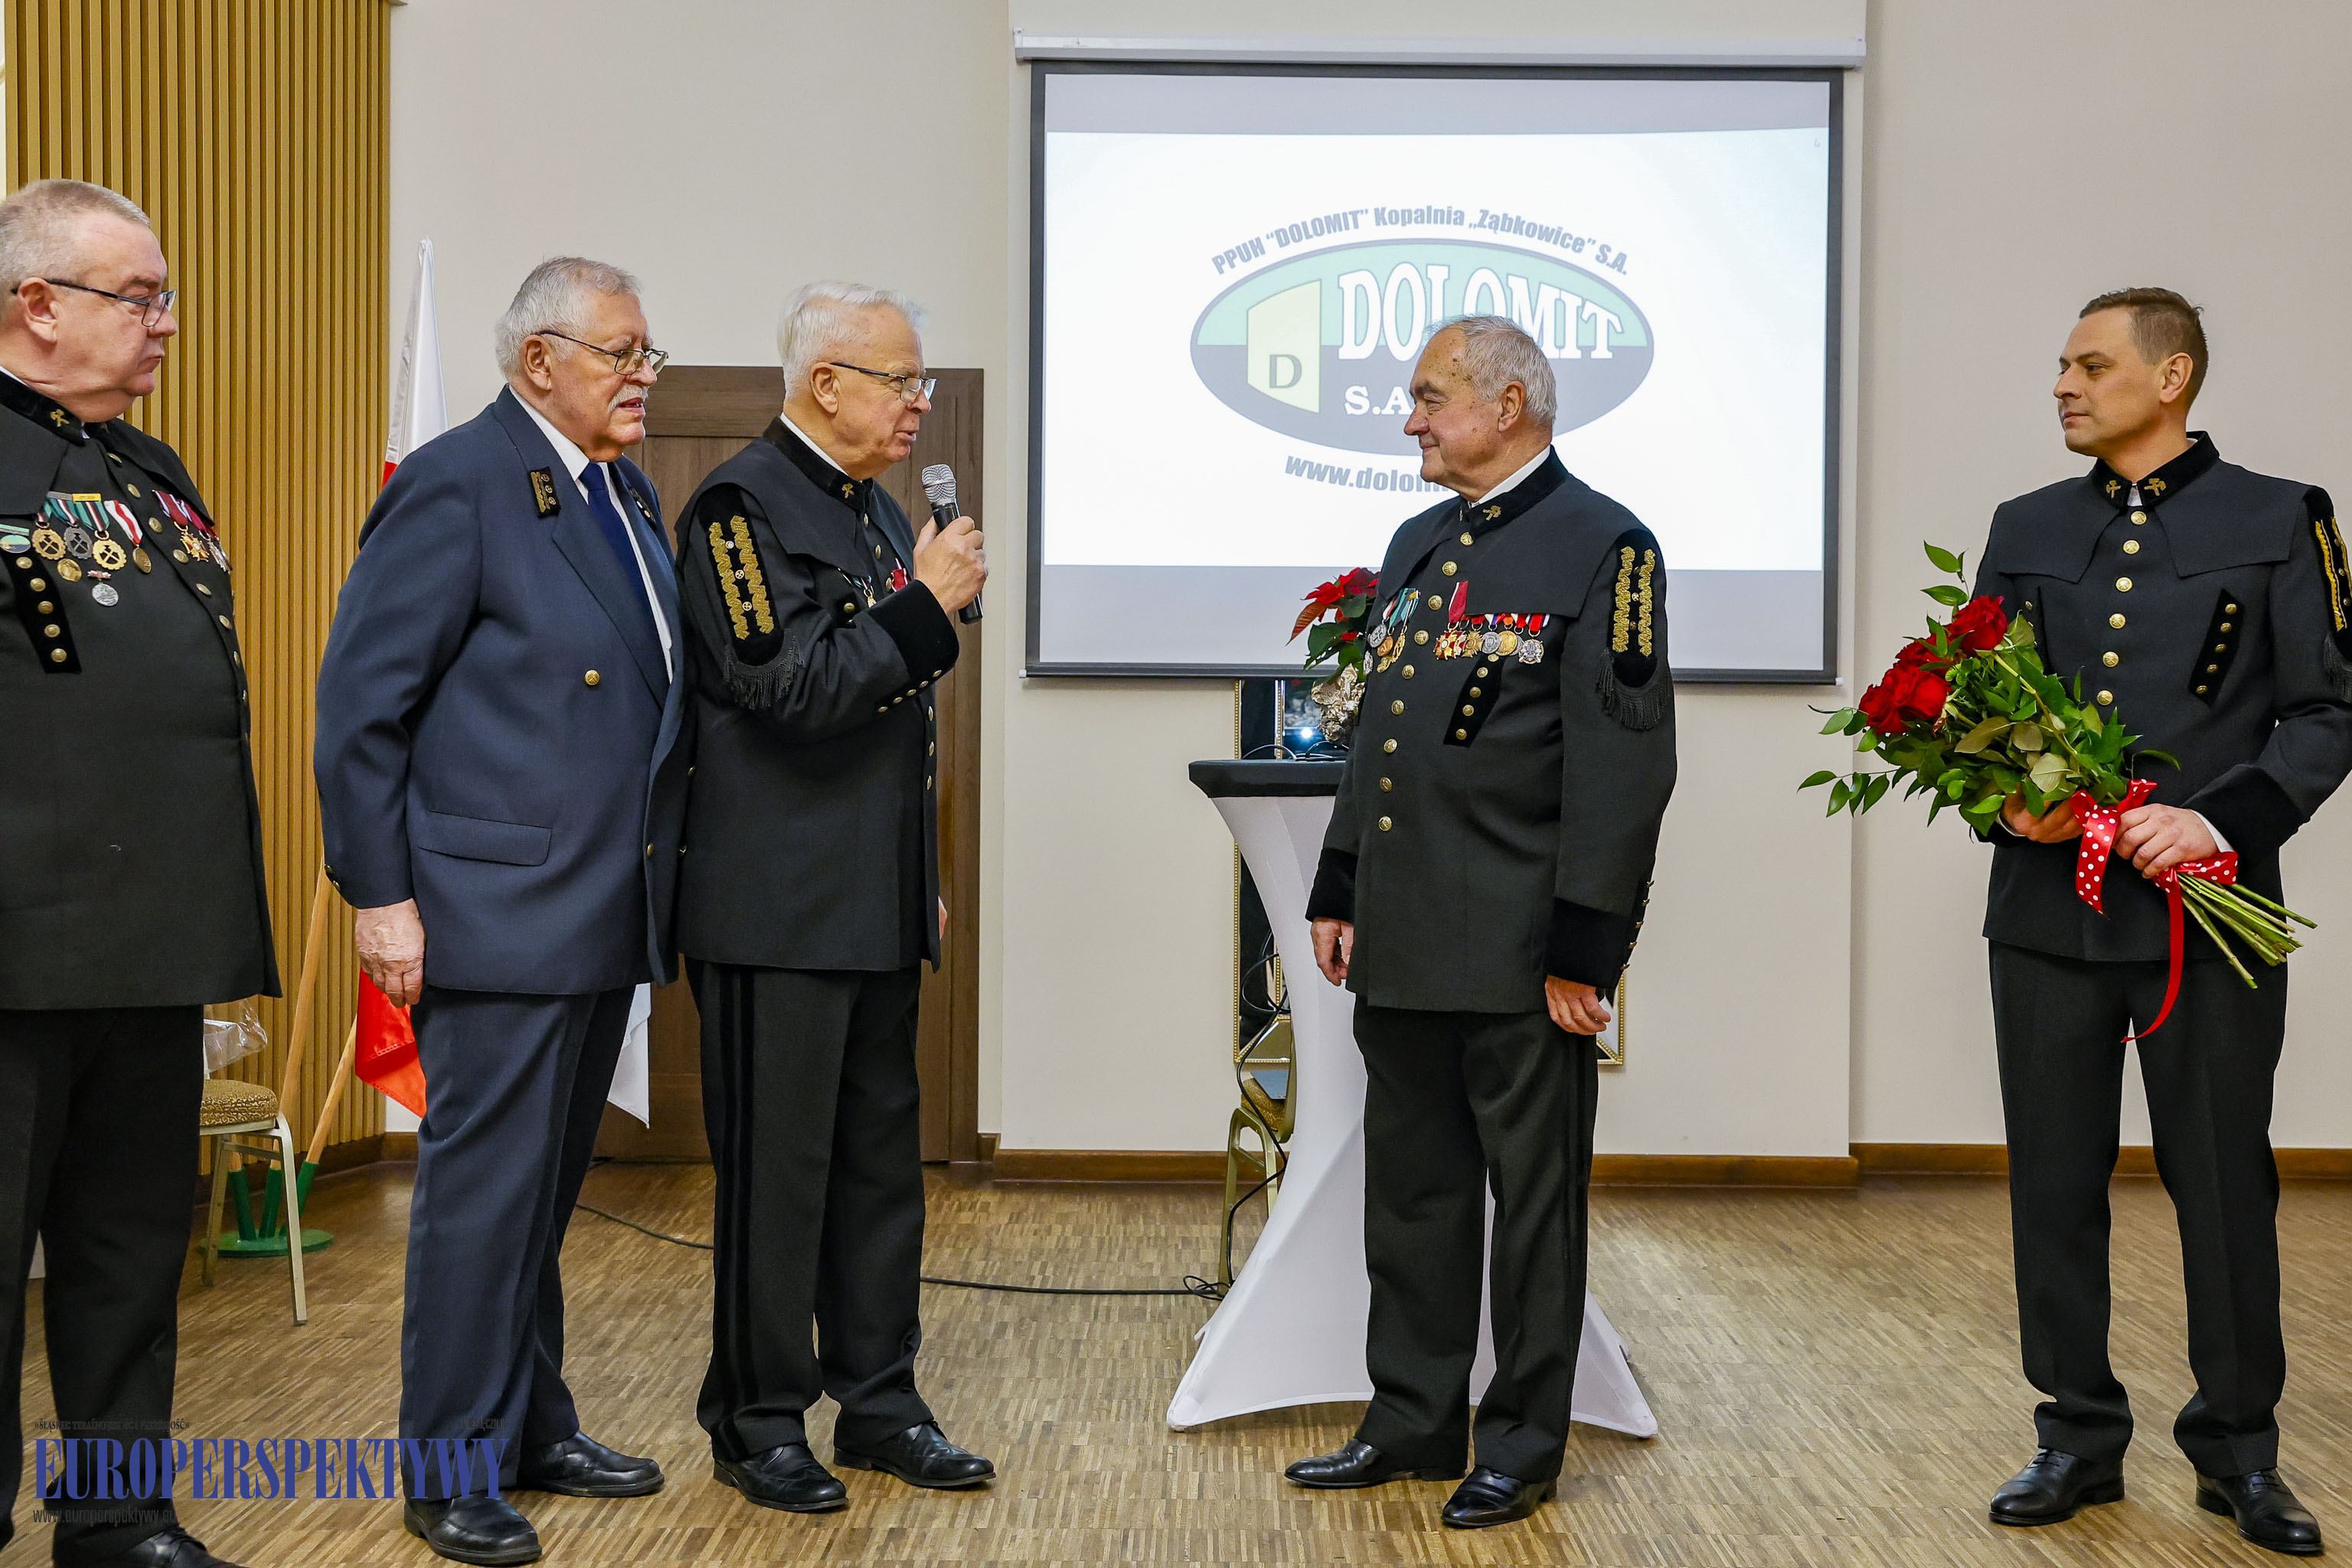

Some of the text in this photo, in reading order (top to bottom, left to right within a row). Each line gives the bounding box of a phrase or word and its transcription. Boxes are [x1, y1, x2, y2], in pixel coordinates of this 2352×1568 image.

[1212, 237, 1266, 276] PPUH
[1374, 205, 1464, 227] Kopalnia
[1595, 243, 1628, 276] S.A.
[1269, 354, 1303, 389] D
[1285, 456, 1449, 492] www.dolo
